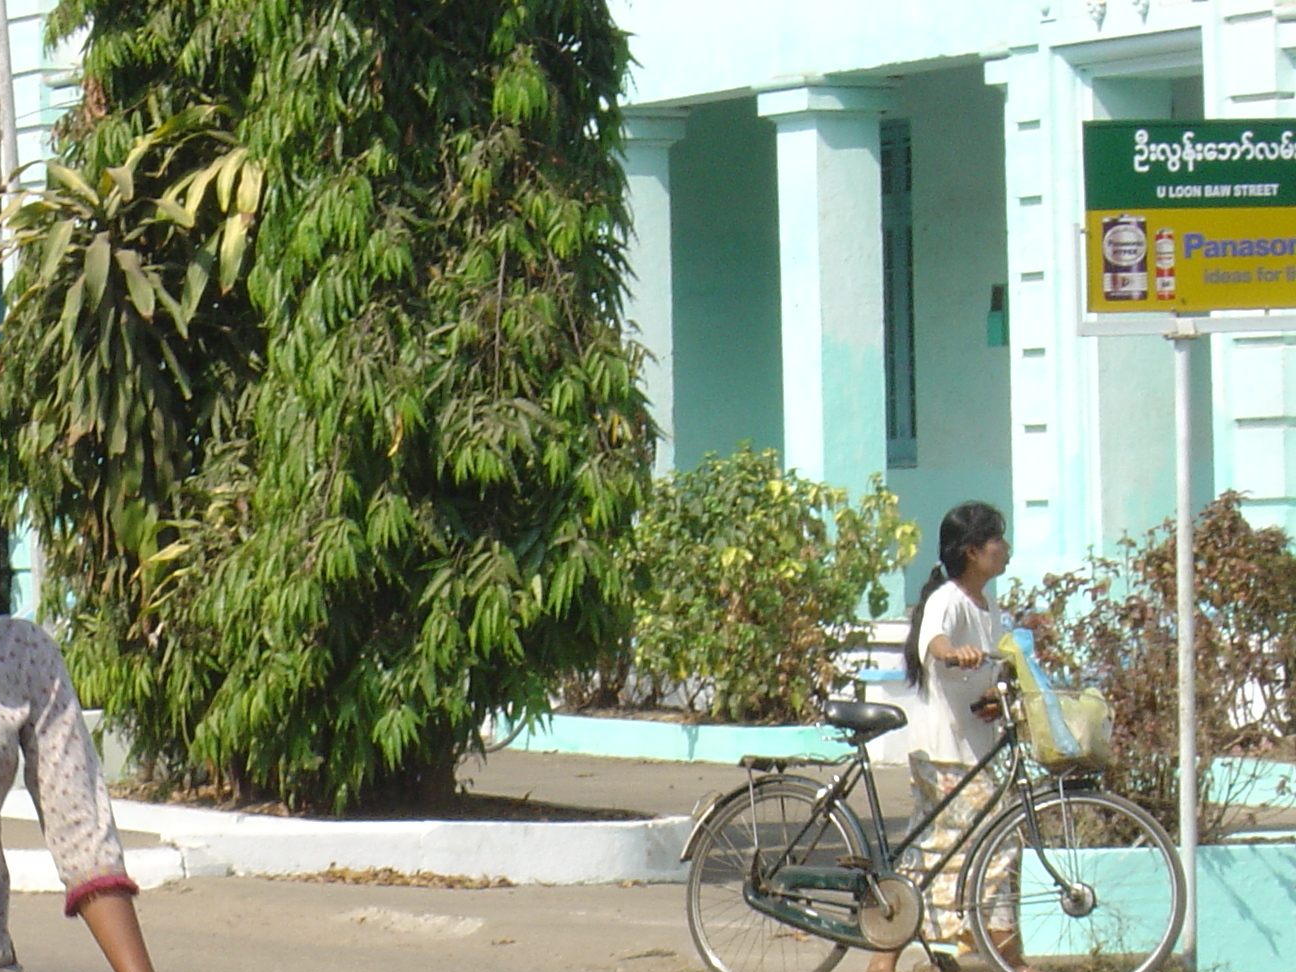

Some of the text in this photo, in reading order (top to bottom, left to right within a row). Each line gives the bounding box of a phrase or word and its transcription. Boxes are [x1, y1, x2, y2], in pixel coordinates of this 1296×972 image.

[1157, 183, 1280, 198] U LOON BAW STREET
[1257, 266, 1282, 282] for
